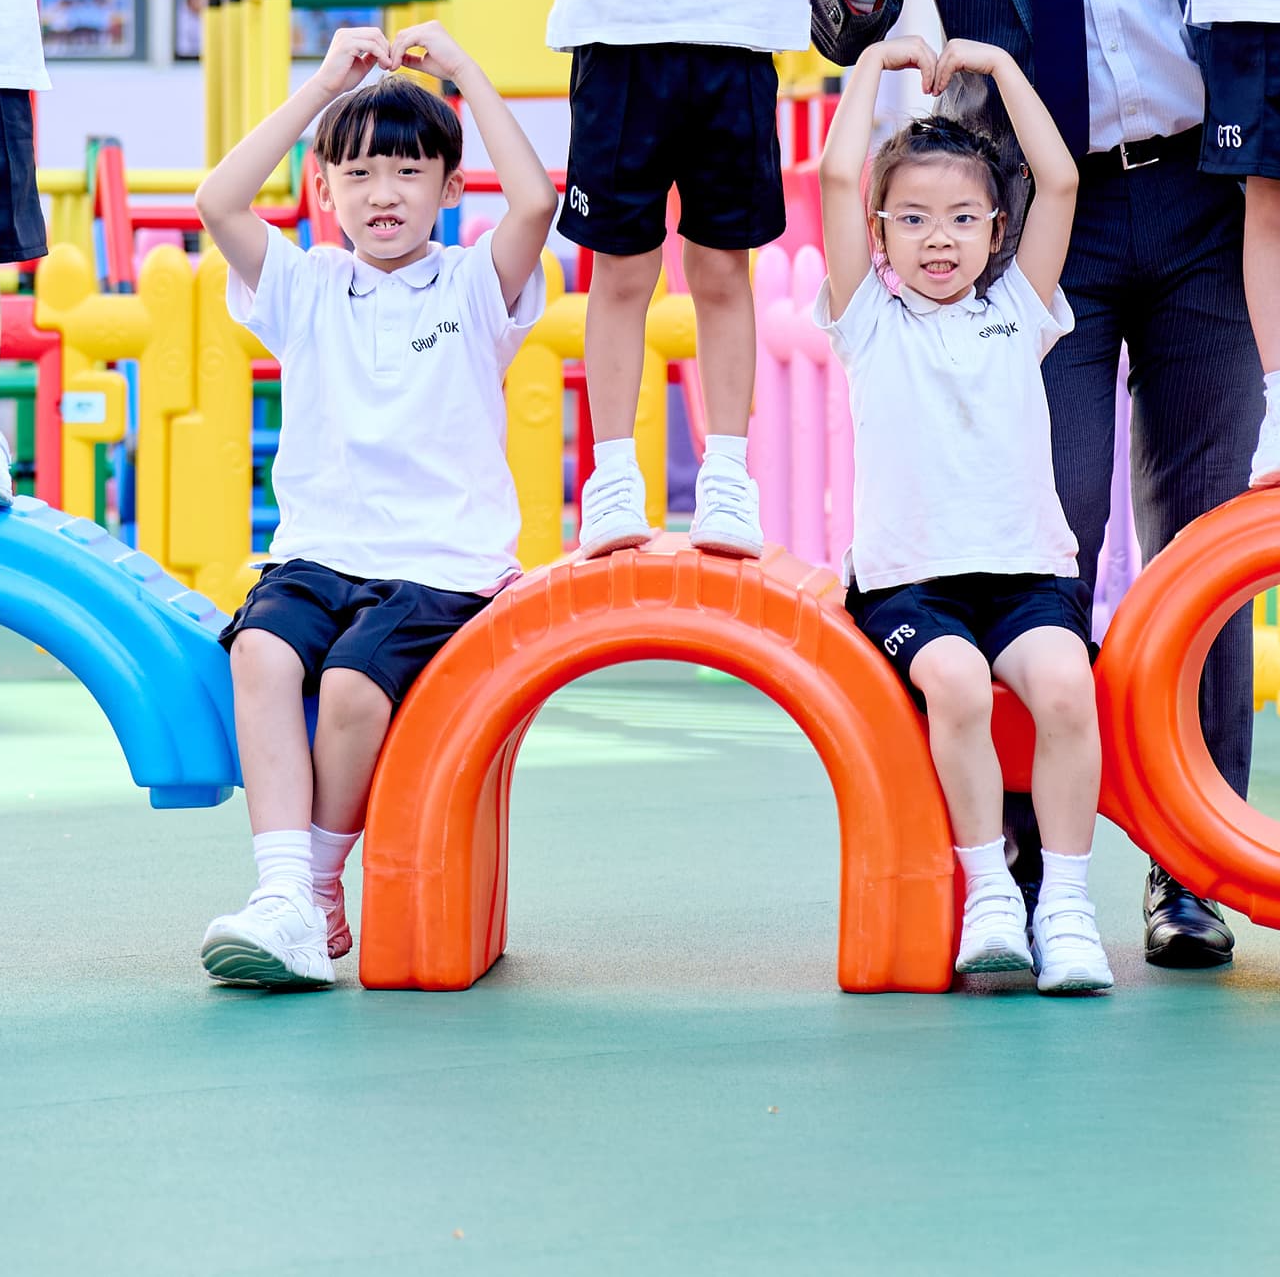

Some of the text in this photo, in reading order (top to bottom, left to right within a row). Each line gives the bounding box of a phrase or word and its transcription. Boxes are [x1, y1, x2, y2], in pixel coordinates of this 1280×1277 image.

[1217, 124, 1242, 148] CTS
[411, 321, 460, 353] CHUN TOK
[883, 623, 916, 656] CTS
